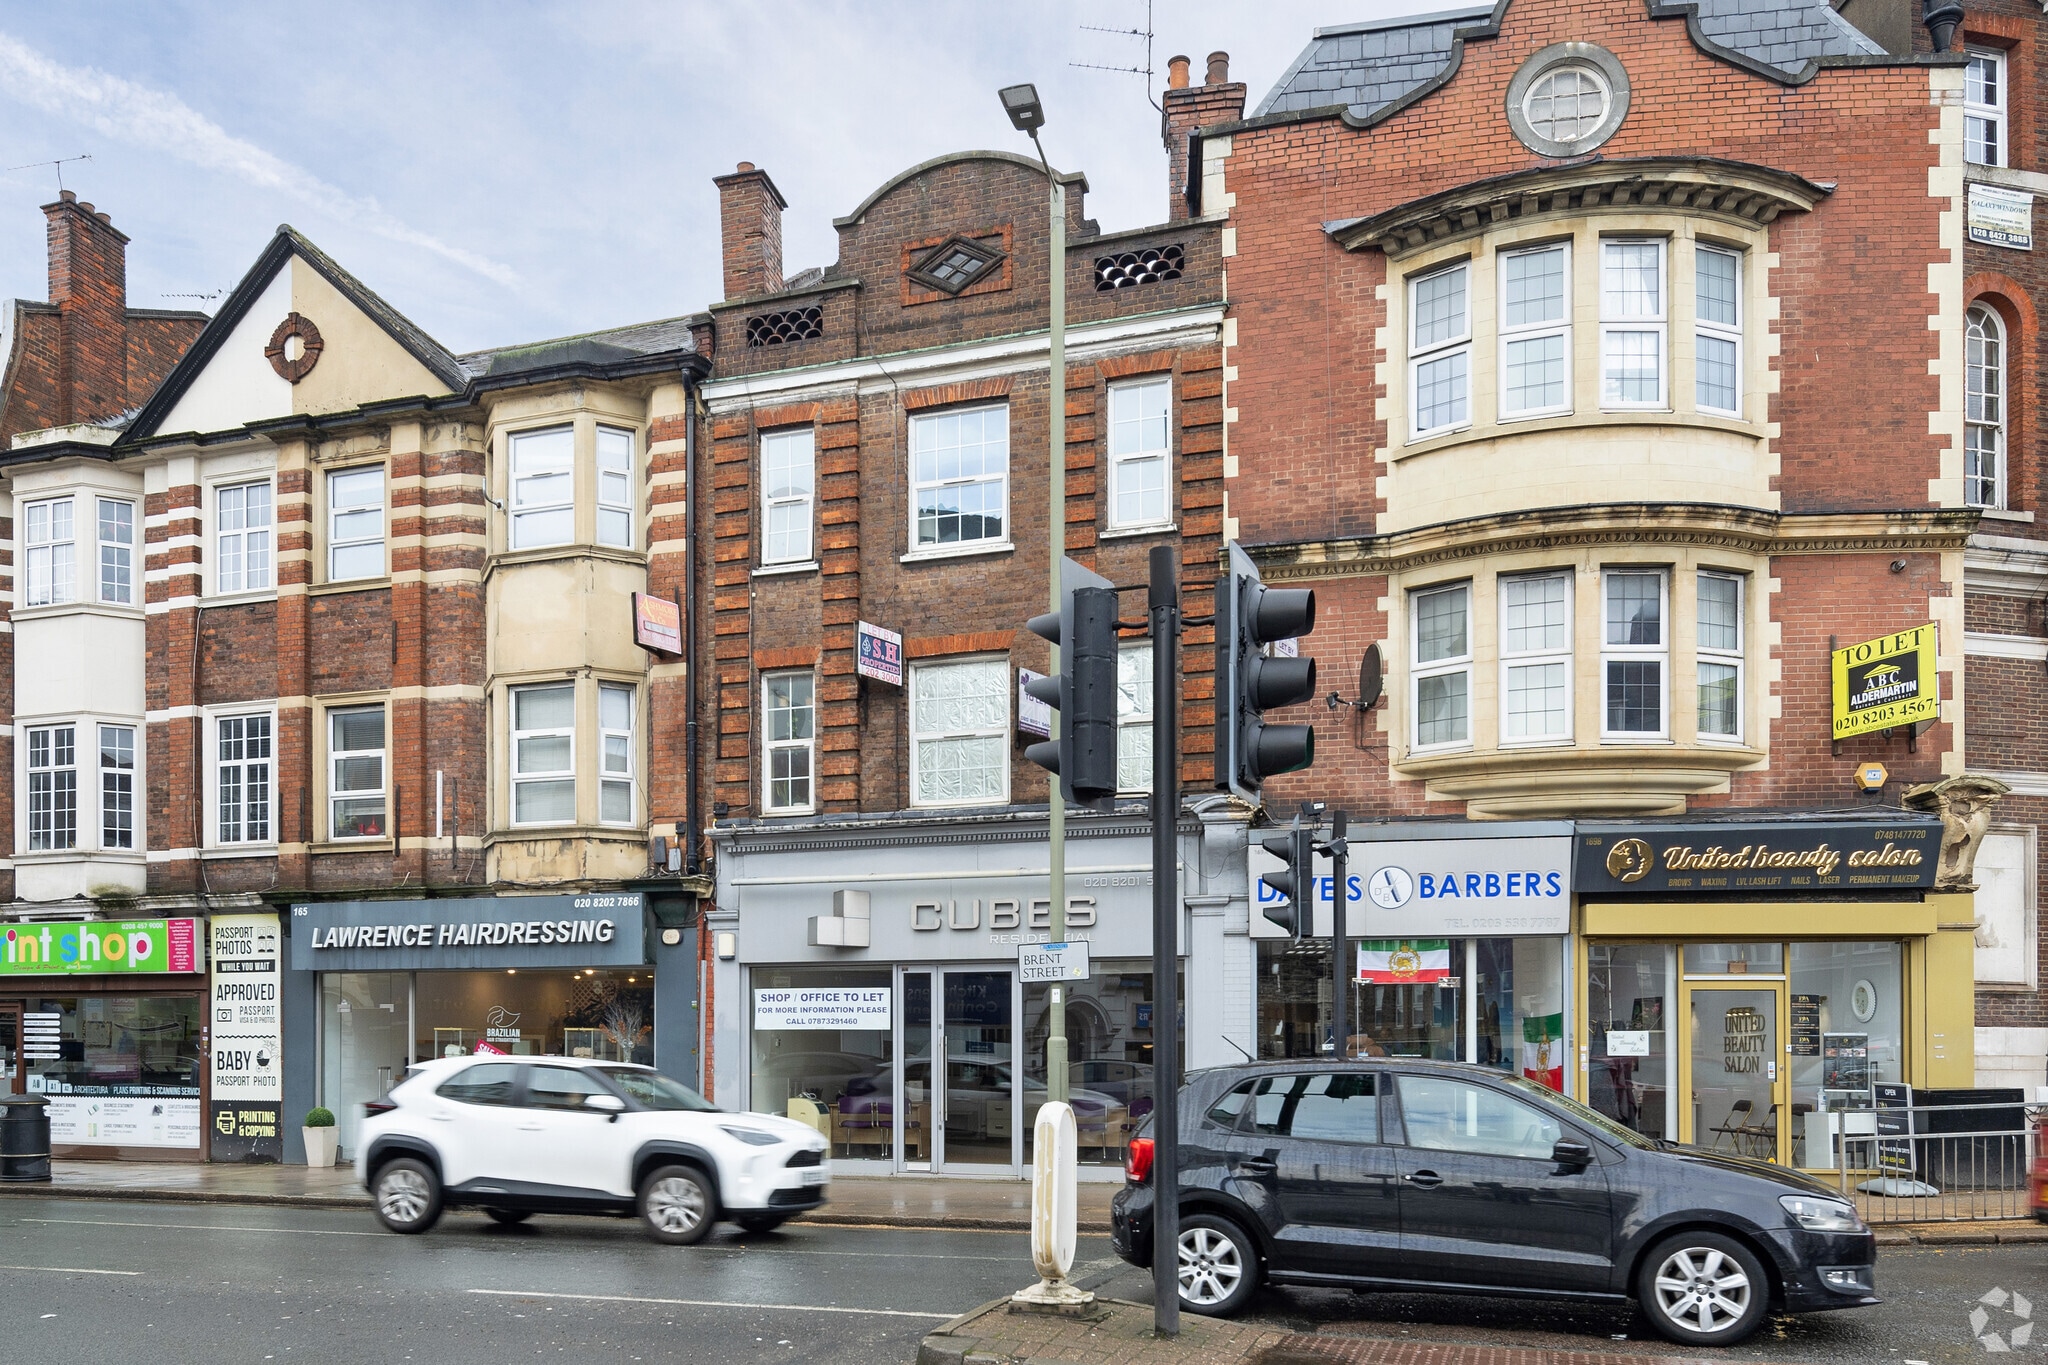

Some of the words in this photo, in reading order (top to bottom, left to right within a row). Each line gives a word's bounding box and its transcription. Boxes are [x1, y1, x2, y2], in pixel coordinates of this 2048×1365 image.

[1973, 227, 1987, 238] 020
[1989, 231, 2007, 241] 8427
[867, 624, 881, 638] LET
[883, 630, 896, 641] BY
[1841, 642, 1873, 666] TO
[1878, 628, 1926, 657] LET
[860, 656, 900, 675] PROPERTIES
[865, 667, 880, 679] 202
[881, 671, 900, 685] 3000
[1866, 670, 1901, 690] ABC
[1850, 679, 1917, 706] ALDERMARTIN
[1836, 714, 1860, 732] 020
[1863, 707, 1895, 725] 8203
[1899, 697, 1934, 718] 4567
[1874, 830, 1927, 840] 07481477720
[1663, 846, 1752, 870] United
[1750, 843, 1841, 876] beauty
[1848, 842, 1923, 868] salon
[1084, 878, 1108, 887] 020
[1112, 876, 1141, 887] 8201
[1419, 872, 1561, 898] BARBERS
[1668, 878, 1692, 887] BROWS
[1701, 878, 1727, 886] WAXING
[1736, 877, 1748, 886] LVL
[1749, 877, 1767, 885] LASH
[1767, 876, 1782, 885] LIFT
[1791, 876, 1811, 885] NAILS
[1819, 876, 1841, 884] LASER
[1849, 875, 1890, 884] PERMANENT
[1891, 874, 1920, 883] MAKEUP
[574, 898, 591, 908] 020
[593, 897, 614, 907] 8202
[617, 896, 639, 906] 7866
[293, 907, 308, 916] 165
[911, 895, 1097, 931] CUBES
[121, 922, 136, 930] 0208
[148, 921, 164, 930] 9000
[1445, 918, 1469, 928] TEL.
[1472, 917, 1502, 928] 0203
[1530, 917, 1561, 927] 7787
[215, 927, 253, 939] PASSPORT
[311, 924, 434, 949] LAWRENCE
[438, 919, 615, 946] HAIRDRESSING
[990, 932, 1095, 944] RESIDETIAL
[60, 925, 153, 968] shop
[215, 941, 252, 955] PHOTOS
[1024, 954, 1062, 965] BRENT
[221, 963, 240, 971] WHILE
[241, 962, 254, 971] YOU
[254, 962, 270, 970] WAIT
[1023, 966, 1066, 979] STREET
[216, 983, 275, 1001] APPROVED
[761, 994, 791, 1002] SHOP
[800, 993, 840, 1002] OFFICE
[843, 993, 859, 1001] TO
[863, 993, 884, 1001] LET
[239, 1005, 275, 1015] PASSPORT
[1724, 1014, 1766, 1033] UNITED
[487, 1028, 520, 1037] BRAZILIAN
[1723, 1034, 1767, 1053] BEAUTY
[217, 1051, 251, 1070] BABY
[1724, 1056, 1760, 1073] SALON
[216, 1075, 250, 1086] PASSPORT
[253, 1075, 276, 1086] PHOTO
[113, 1086, 129, 1095] PLANS
[129, 1086, 151, 1095] PRINTING
[157, 1087, 180, 1095] SCANNING
[238, 1111, 276, 1123] PRINTING
[238, 1125, 244, 1136] &
[245, 1125, 276, 1137] COPYING
